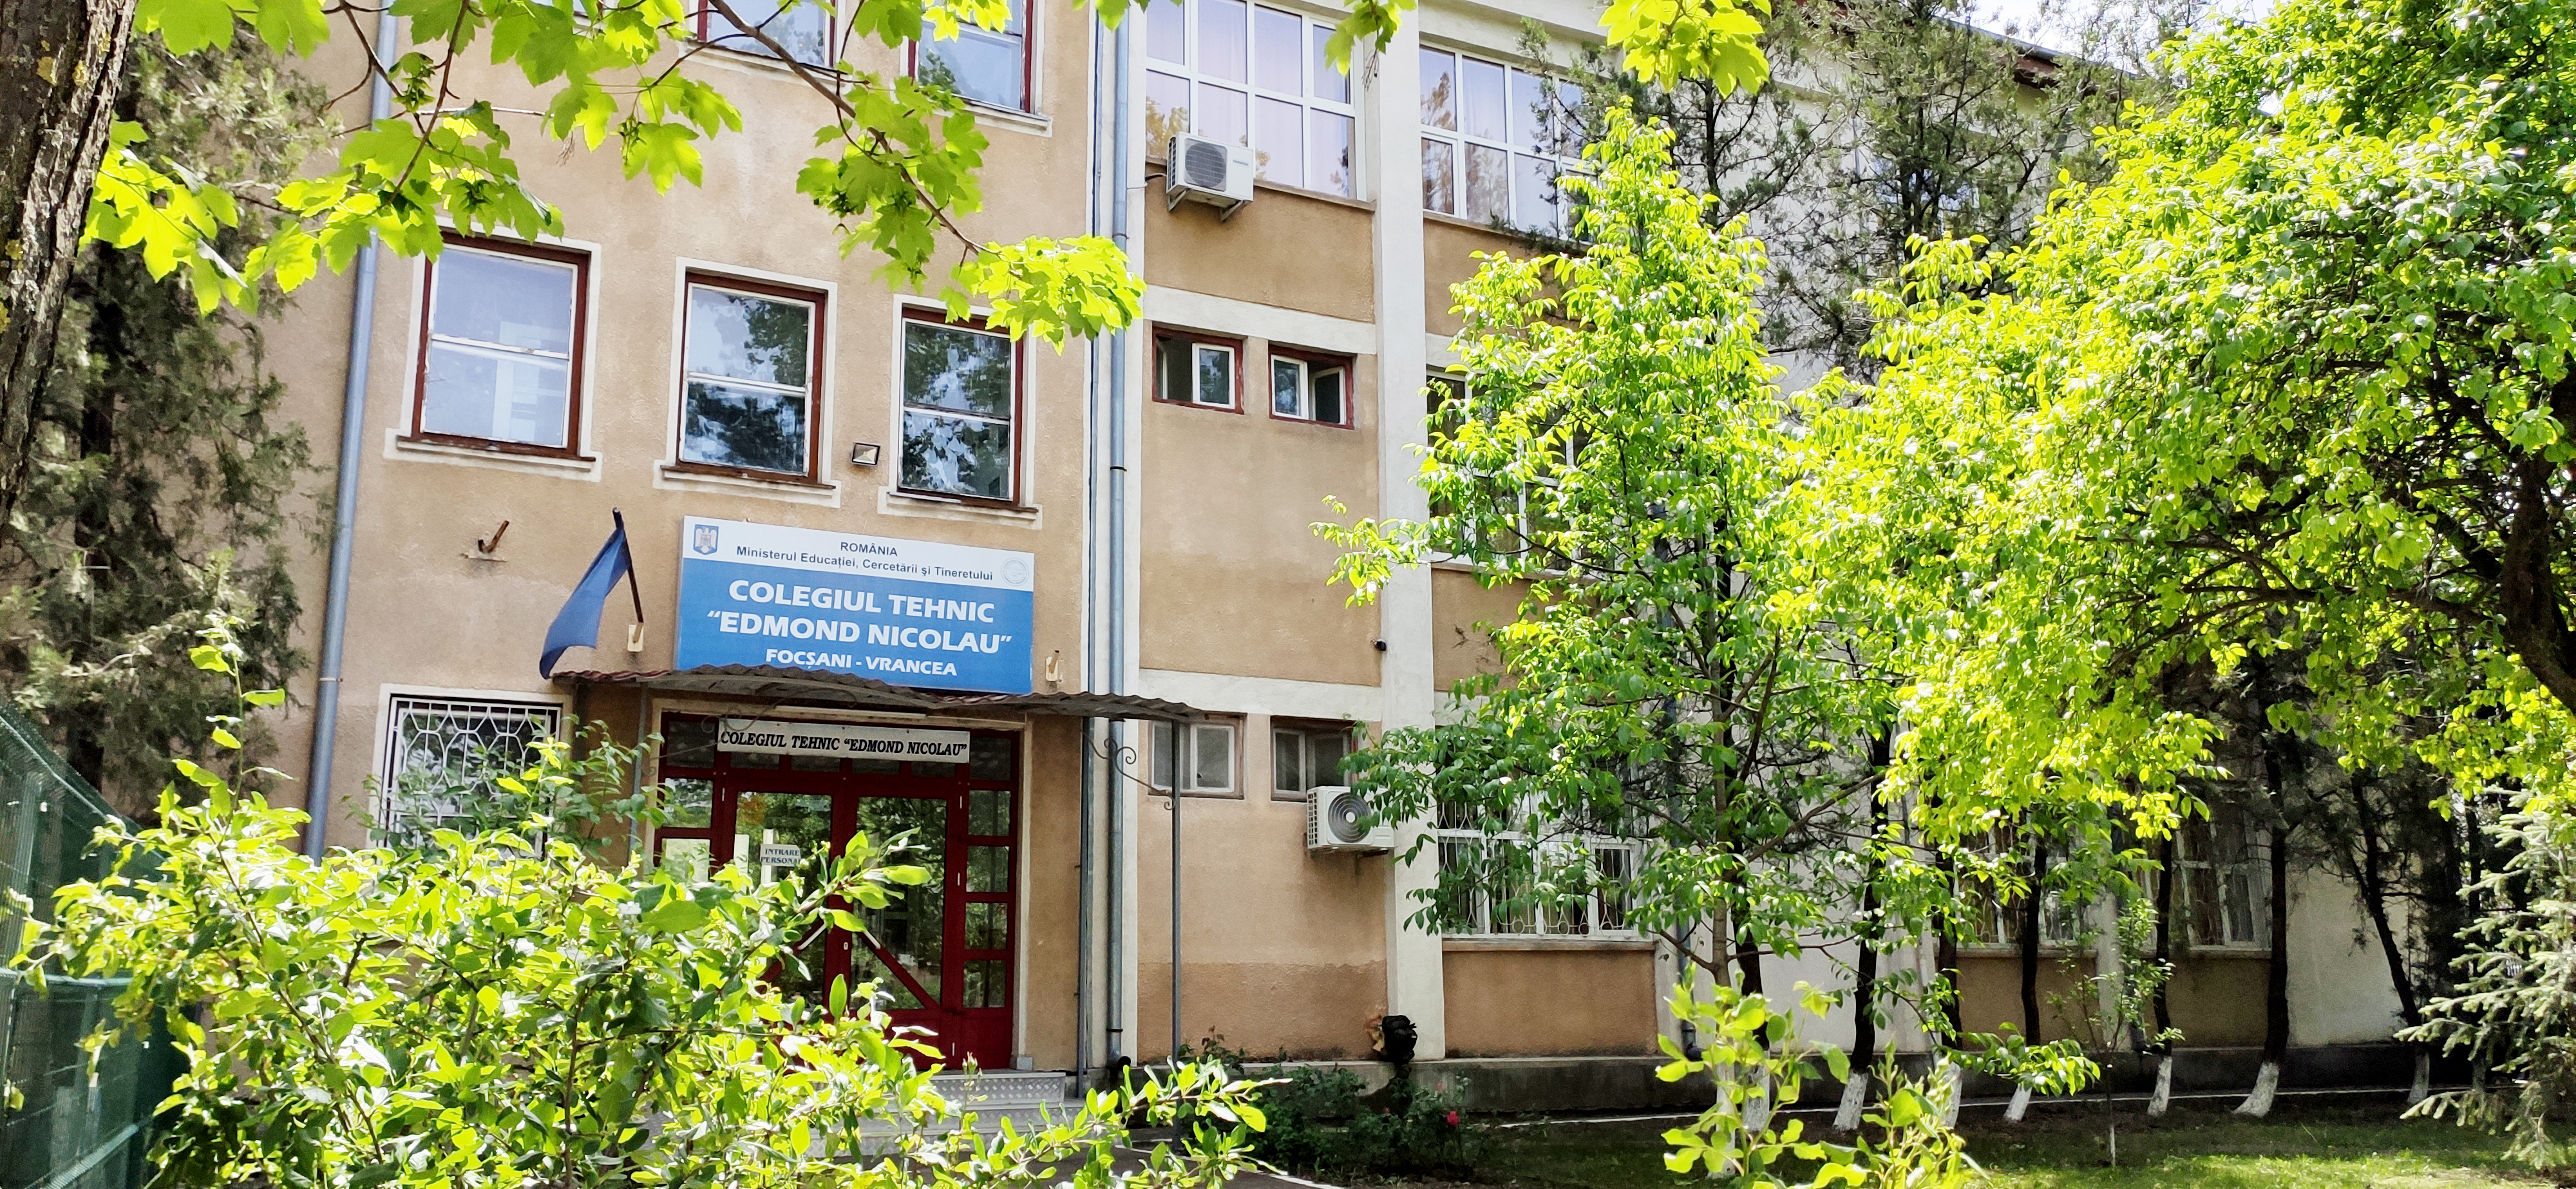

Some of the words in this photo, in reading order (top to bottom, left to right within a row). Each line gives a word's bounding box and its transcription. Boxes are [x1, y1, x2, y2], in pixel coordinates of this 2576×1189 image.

[736, 546, 797, 561] Ministerul
[863, 559, 918, 573] Cercetării
[934, 566, 992, 580] Tineretului
[840, 542, 898, 556] ROMÂNIA
[728, 580, 882, 613] COLEGIUL
[888, 594, 995, 623] TEHNIC
[707, 610, 860, 642] “EDMOND
[867, 624, 1012, 654] NICOLAU”
[766, 649, 851, 669] FOCȘANI
[866, 656, 958, 676] VRANCEA
[721, 731, 787, 747] COLEGIUL
[791, 735, 840, 750] TEHNIC
[844, 738, 904, 754] “EDMOND
[907, 741, 967, 756] NICOLAU”
